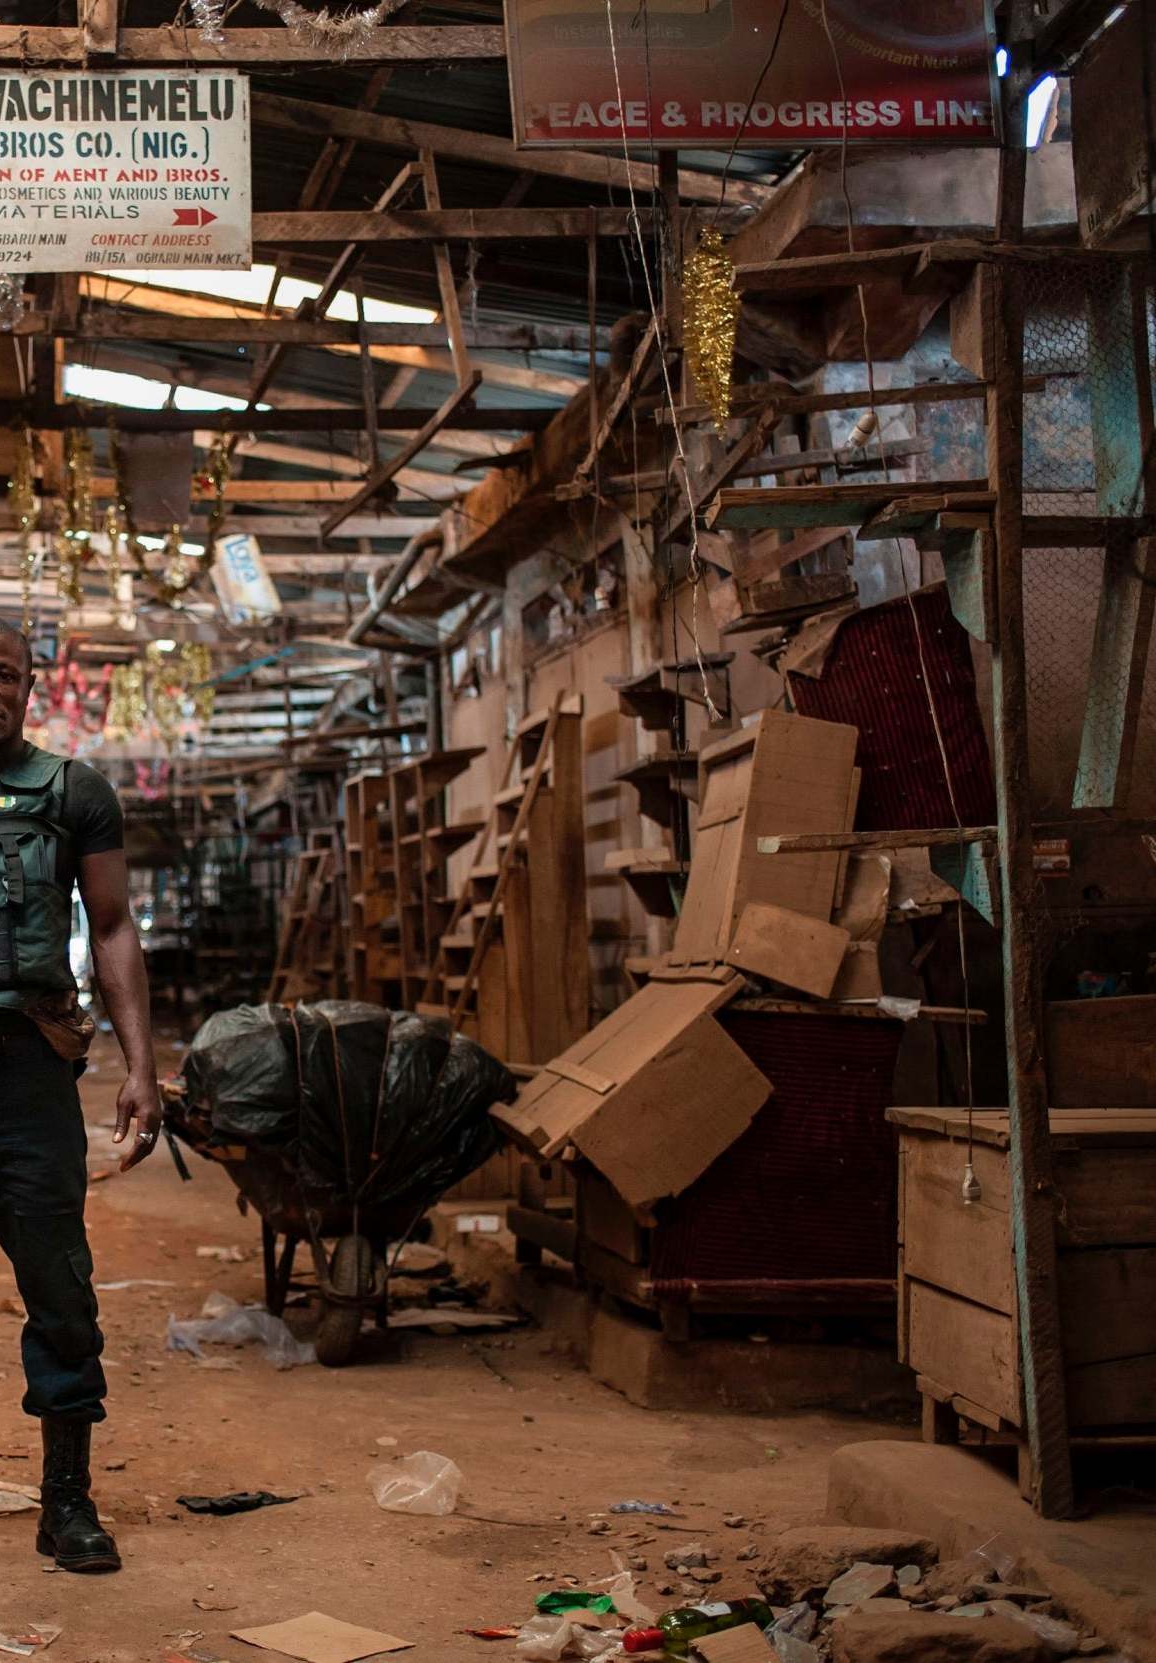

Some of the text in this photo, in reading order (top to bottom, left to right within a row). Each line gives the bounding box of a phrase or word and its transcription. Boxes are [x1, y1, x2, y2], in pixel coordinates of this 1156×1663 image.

[525, 100, 648, 129] PEACE
[661, 101, 687, 128] &
[701, 100, 902, 128] PROGRESS
[75, 130, 121, 159] CO.
[19, 167, 45, 183] OF
[53, 167, 108, 183] MENT
[116, 167, 159, 183] AND
[166, 167, 229, 183] BROS.
[73, 186, 103, 201] AND
[109, 186, 168, 201] VARIOUS
[174, 186, 231, 201] BEAUTY
[38, 233, 67, 245] MAIN
[91, 234, 212, 247] CONTACT ADDRESS
[183, 252, 213, 265] MAIN
